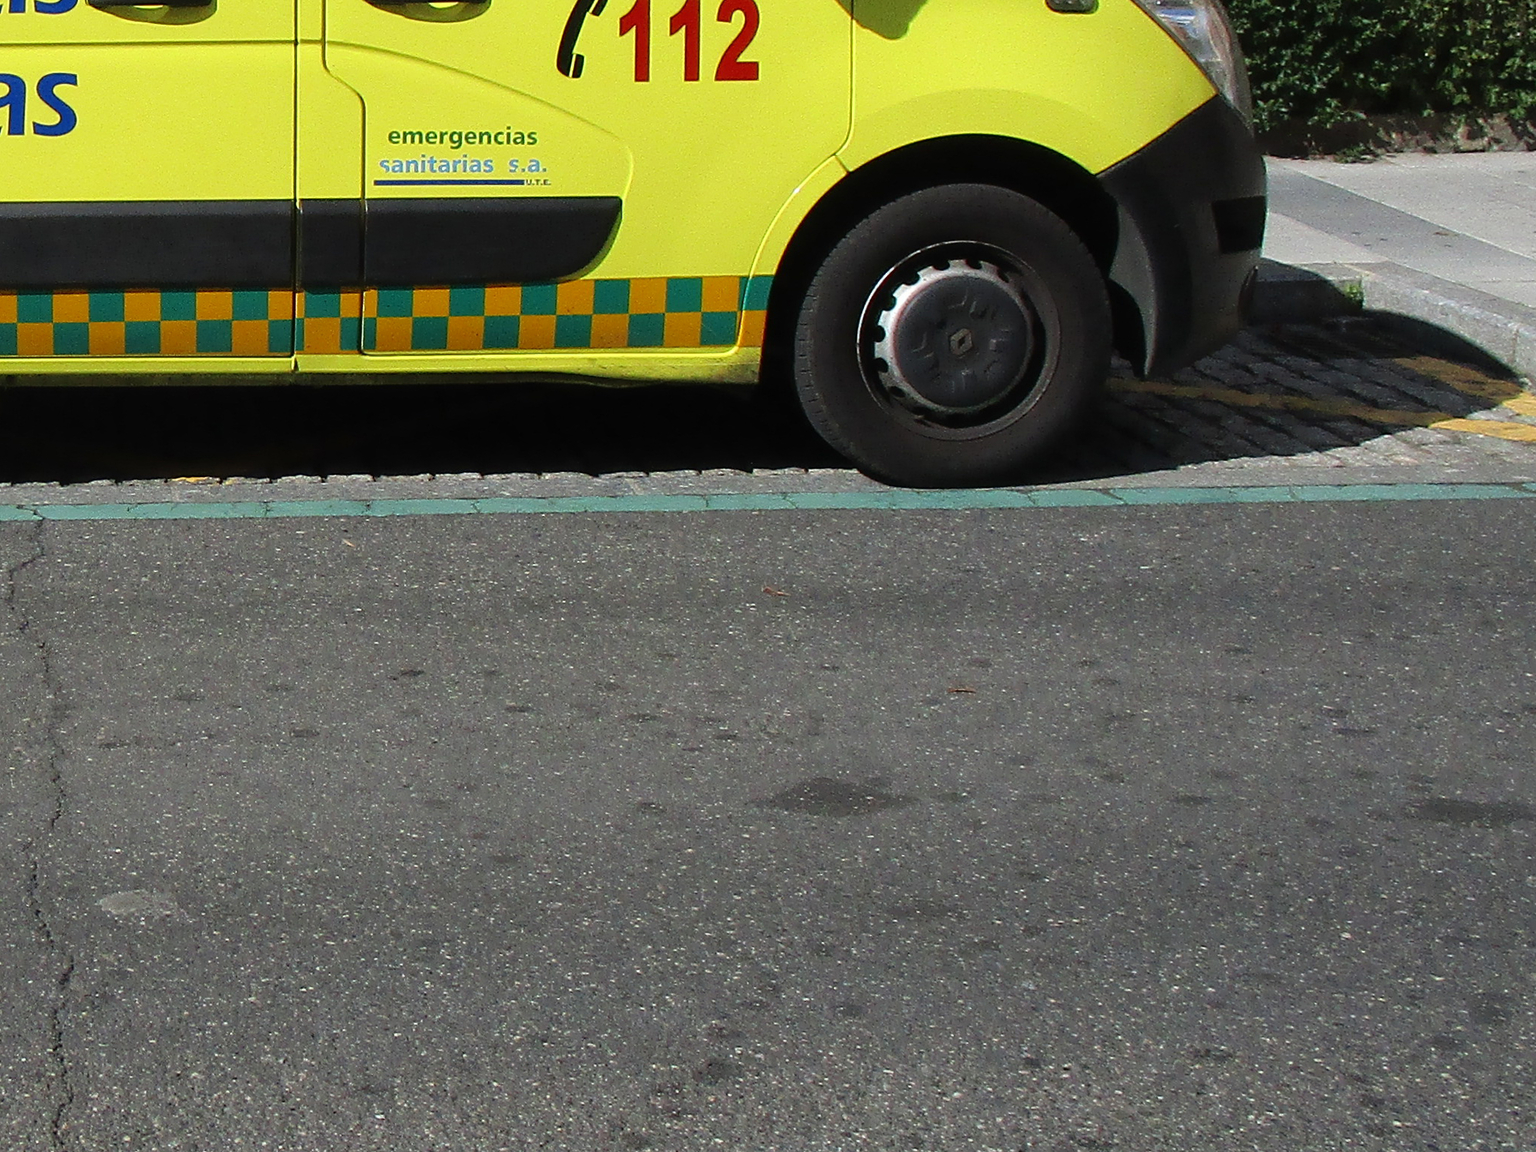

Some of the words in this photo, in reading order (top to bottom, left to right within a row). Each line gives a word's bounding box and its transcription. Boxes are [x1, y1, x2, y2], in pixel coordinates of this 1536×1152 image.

[387, 126, 538, 150] emergencias
[379, 154, 494, 173] sanitarias
[508, 158, 547, 173] s.a.
